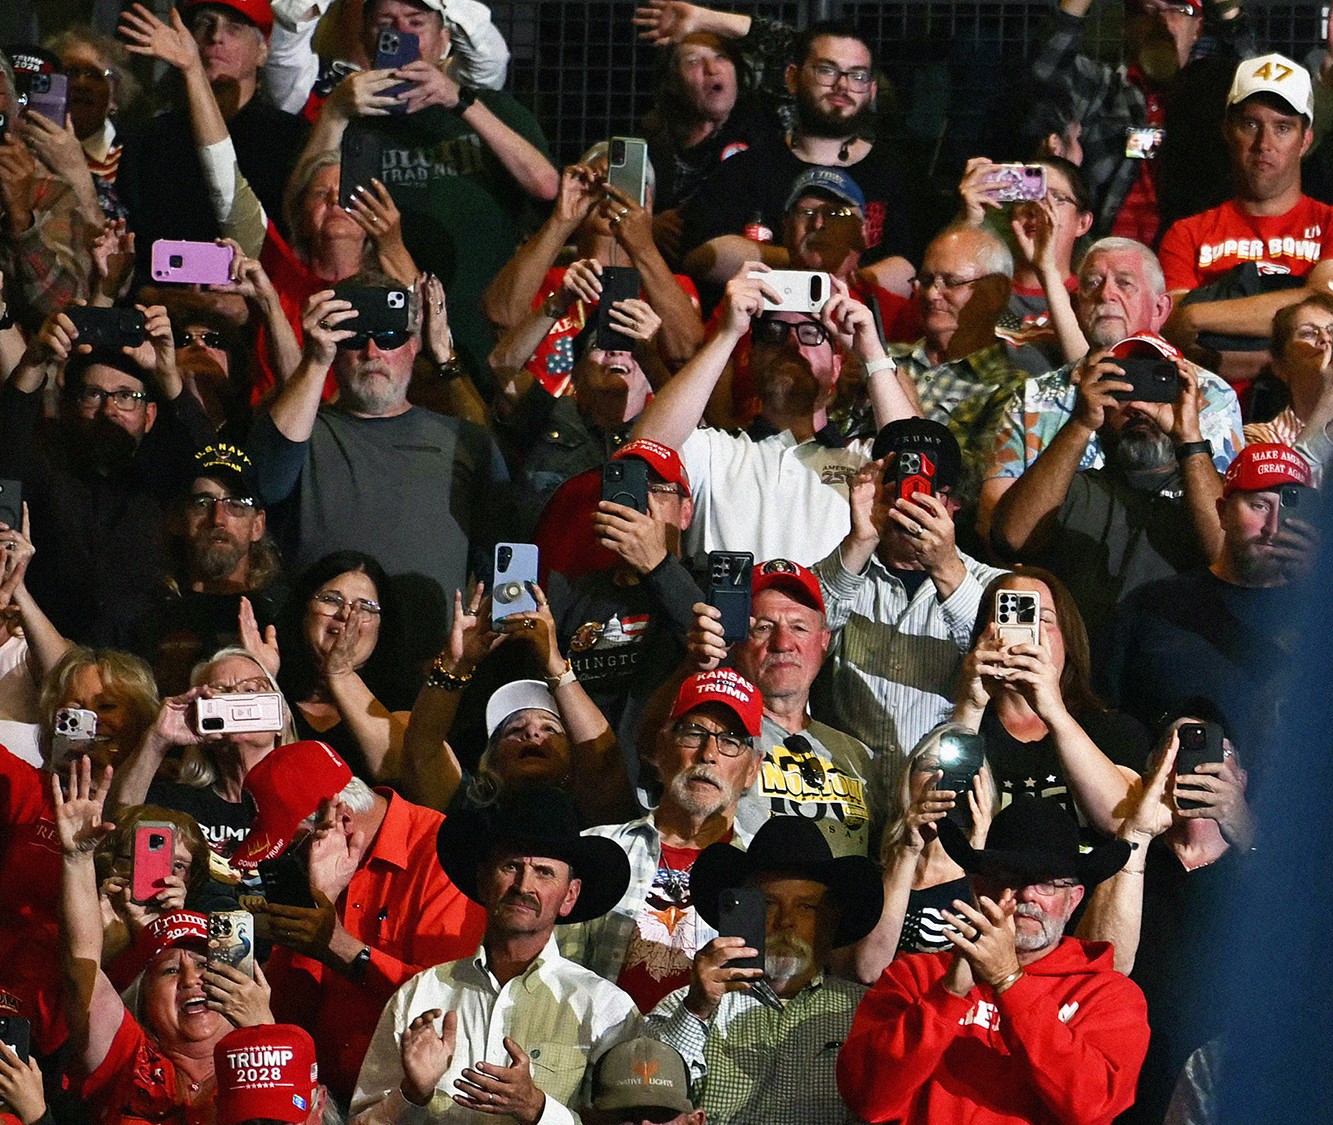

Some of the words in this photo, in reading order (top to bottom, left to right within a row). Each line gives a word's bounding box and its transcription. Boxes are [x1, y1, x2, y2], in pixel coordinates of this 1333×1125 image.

[1252, 62, 1294, 82] 47
[1199, 240, 1264, 267] SUPER
[218, 443, 252, 466] NAVY
[1252, 450, 1279, 463] MAKE
[1257, 464, 1286, 475] GREAT
[696, 670, 754, 692] KANSAS
[717, 679, 736, 688] FOR
[696, 684, 750, 703] TRUMP
[198, 822, 251, 843] RUM
[266, 838, 284, 860] TRUMP
[149, 913, 208, 935] Trump
[166, 927, 198, 940] 2024
[227, 1050, 293, 1069] TRUMP
[236, 1068, 282, 1083] 2028
[648, 1077, 674, 1088] LIGHTS
